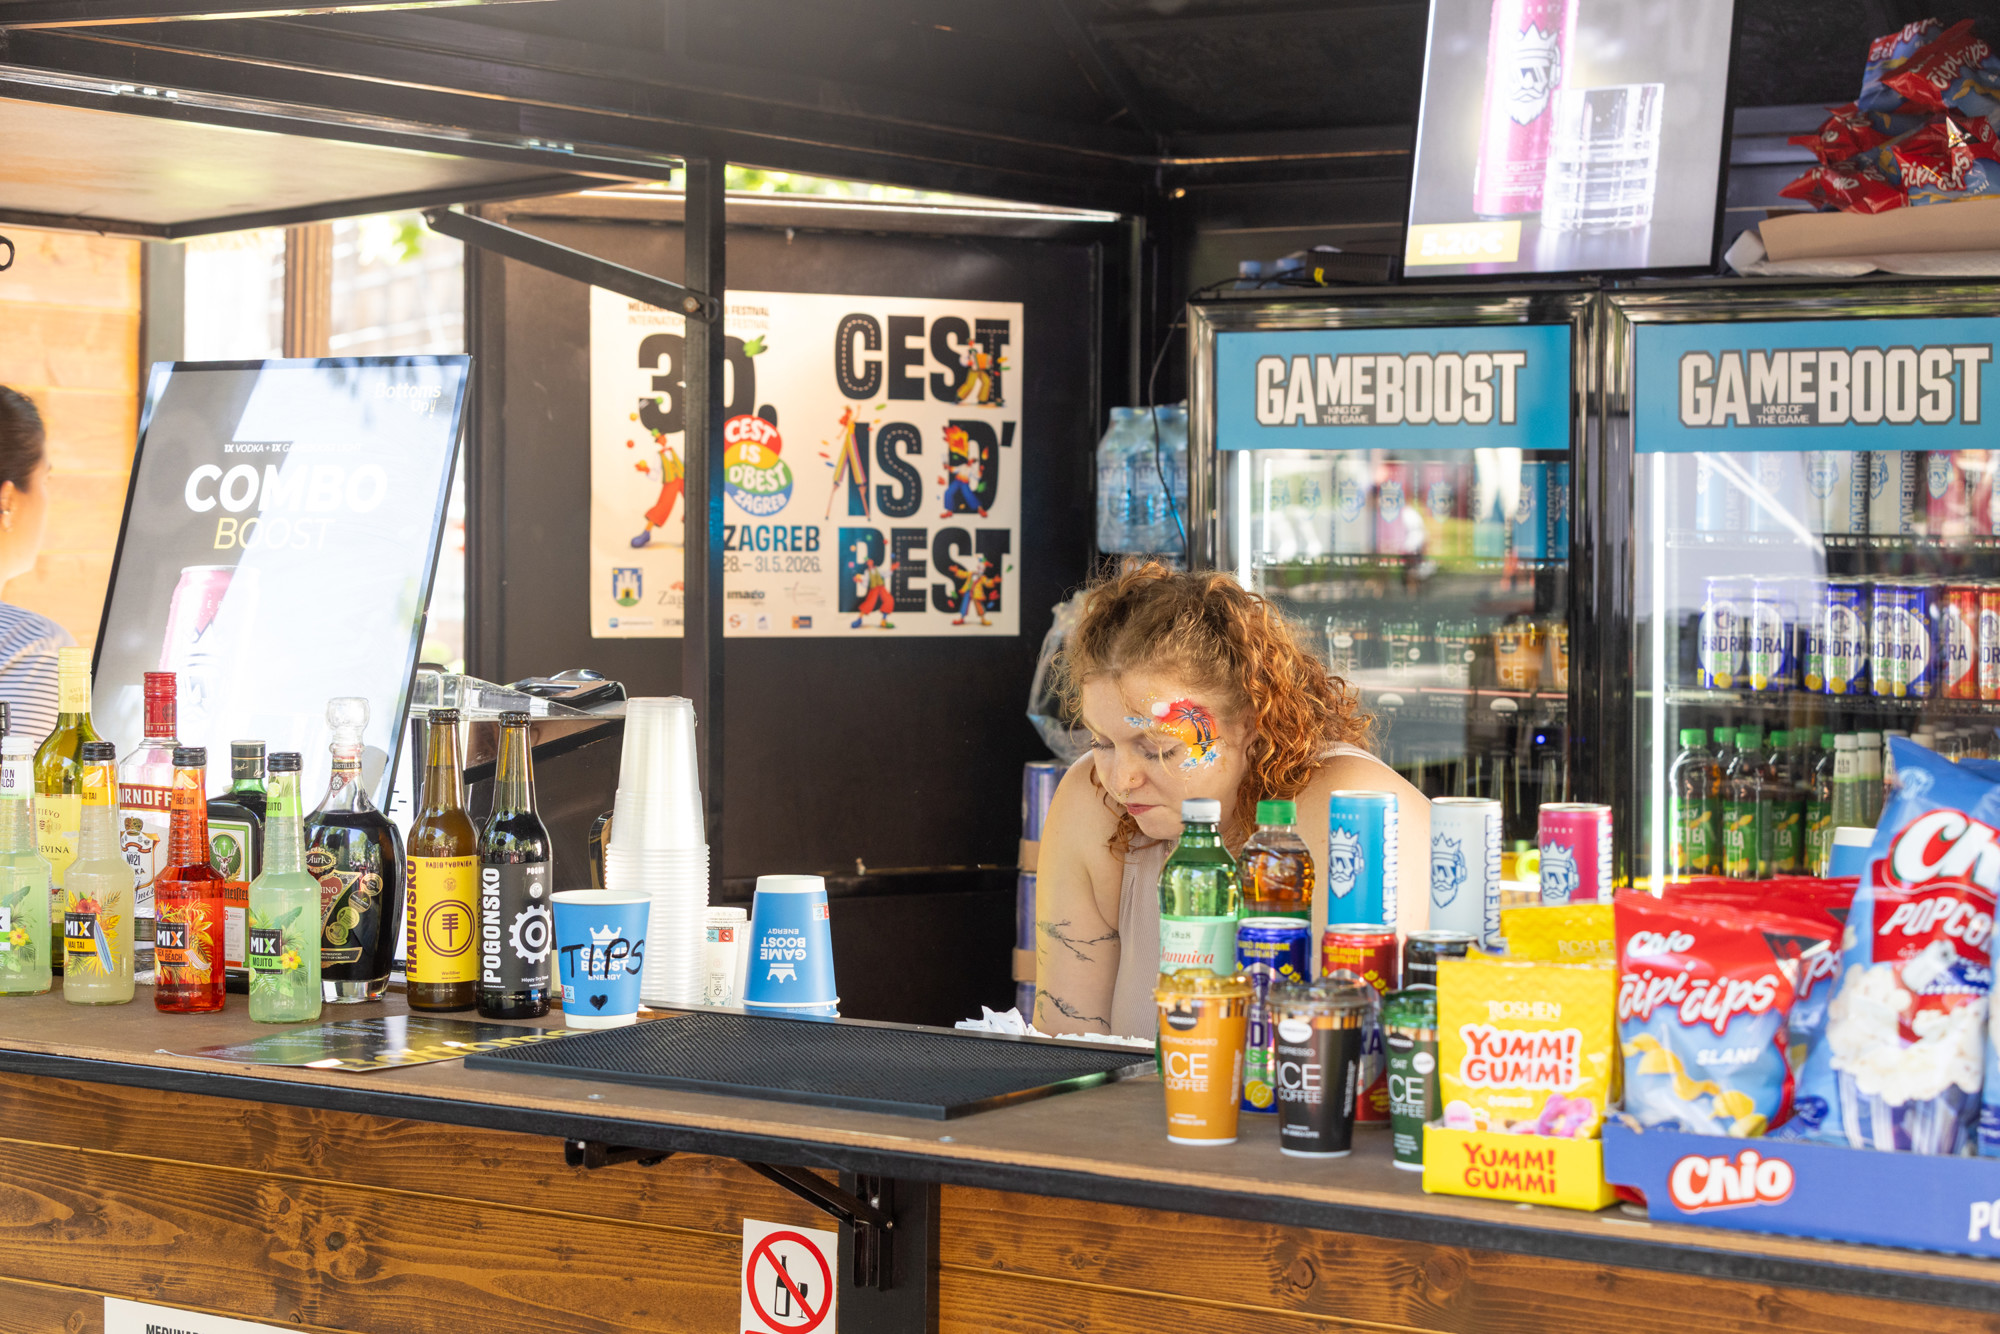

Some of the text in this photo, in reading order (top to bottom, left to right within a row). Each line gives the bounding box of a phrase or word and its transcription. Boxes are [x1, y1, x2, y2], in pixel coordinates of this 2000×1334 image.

[835, 313, 1010, 405] CEST
[1256, 351, 1526, 426] GAMEBOOST
[1679, 343, 1993, 428] GAMEBOOST
[1322, 414, 1369, 425] THE GAME
[1328, 405, 1363, 416] KING OF
[1756, 414, 1810, 425] THE GAME
[1762, 405, 1803, 415] KING OF
[725, 419, 778, 447] CEST
[235, 444, 264, 453] VODKA
[739, 446, 761, 464] IS
[185, 464, 389, 513] COMBO
[1850, 450, 1869, 533] GAMEBOOS
[1900, 450, 1916, 534] GAMEBOOS
[733, 491, 787, 515] ZAGREB
[213, 517, 337, 550] BOOST
[724, 525, 820, 552] ZAGREB
[838, 526, 1011, 613] BEST
[65, 920, 91, 937] MIX
[482, 867, 502, 984] POGONSKO
[1171, 931, 1192, 940] 1828
[1878, 896, 1992, 953] POPCO
[77, 941, 85, 949] TAI
[156, 930, 184, 947] MIX
[250, 936, 277, 954] MIX
[761, 937, 807, 948] BOOST
[1558, 939, 1615, 957] ROSHE
[1626, 930, 1695, 957] Chio
[164, 953, 183, 961] BEACH
[252, 957, 273, 967] MOJITO
[561, 937, 645, 978] TIPS
[581, 960, 629, 971] BOOST
[760, 948, 807, 961] GAME
[1488, 1000, 1561, 1021] ROSHEN
[1467, 1030, 1575, 1064] YUMM!
[1696, 1047, 1760, 1066] SLANI
[1163, 1050, 1209, 1080] ICE
[1276, 1059, 1322, 1090] ICE
[1165, 1076, 1209, 1093] COFFEE
[1278, 1087, 1322, 1104] COFFEE
[1387, 1074, 1425, 1105] CE
[1463, 1143, 1555, 1175] YUMM!
[1670, 1150, 1793, 1211] Chio
